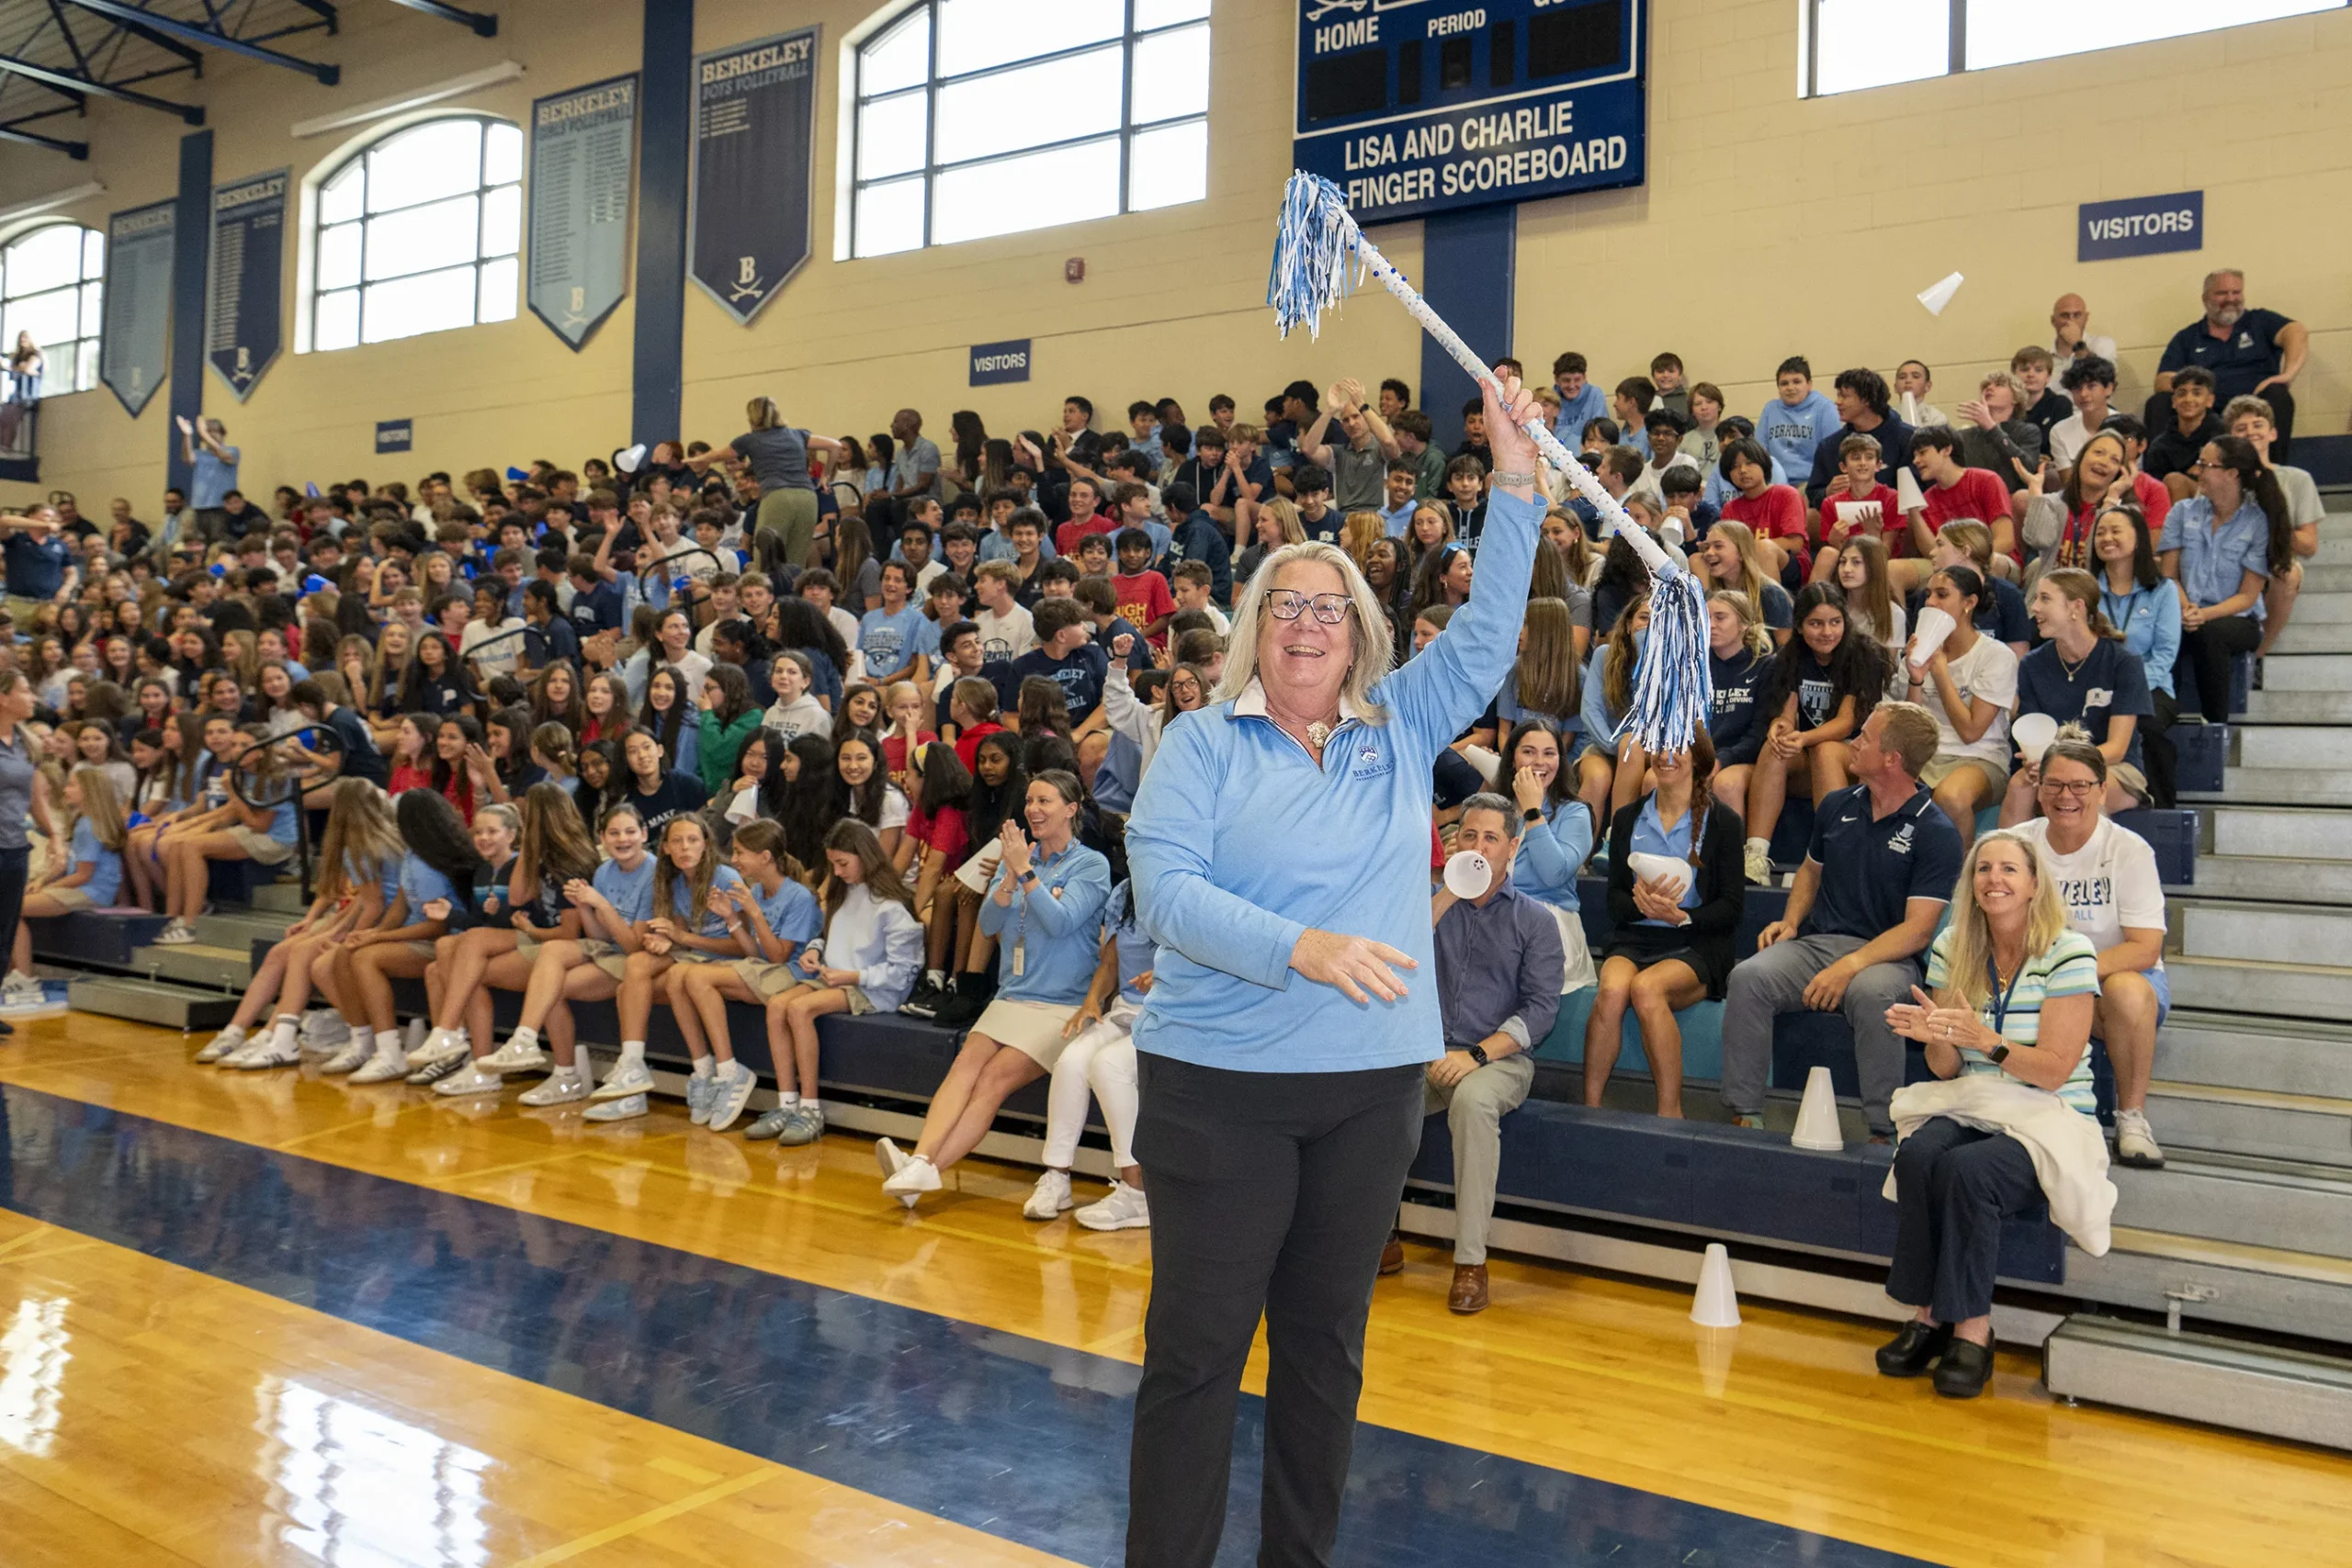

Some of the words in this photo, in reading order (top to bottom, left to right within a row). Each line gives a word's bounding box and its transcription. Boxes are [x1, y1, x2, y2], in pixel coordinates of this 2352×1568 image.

[1314, 16, 1379, 54] HOME
[1427, 8, 1487, 39] PERIOD
[702, 38, 812, 85] BERKELEY
[538, 84, 633, 126] BERKELEY
[1344, 132, 1397, 172] LISA
[1402, 123, 1454, 162] AND
[1460, 99, 1575, 152] CHARLIE
[1338, 167, 1435, 211] FINGER
[1442, 134, 1627, 196] SCOREBOARD
[2088, 209, 2194, 241] VISITORS
[974, 352, 1026, 373] VISITORS
